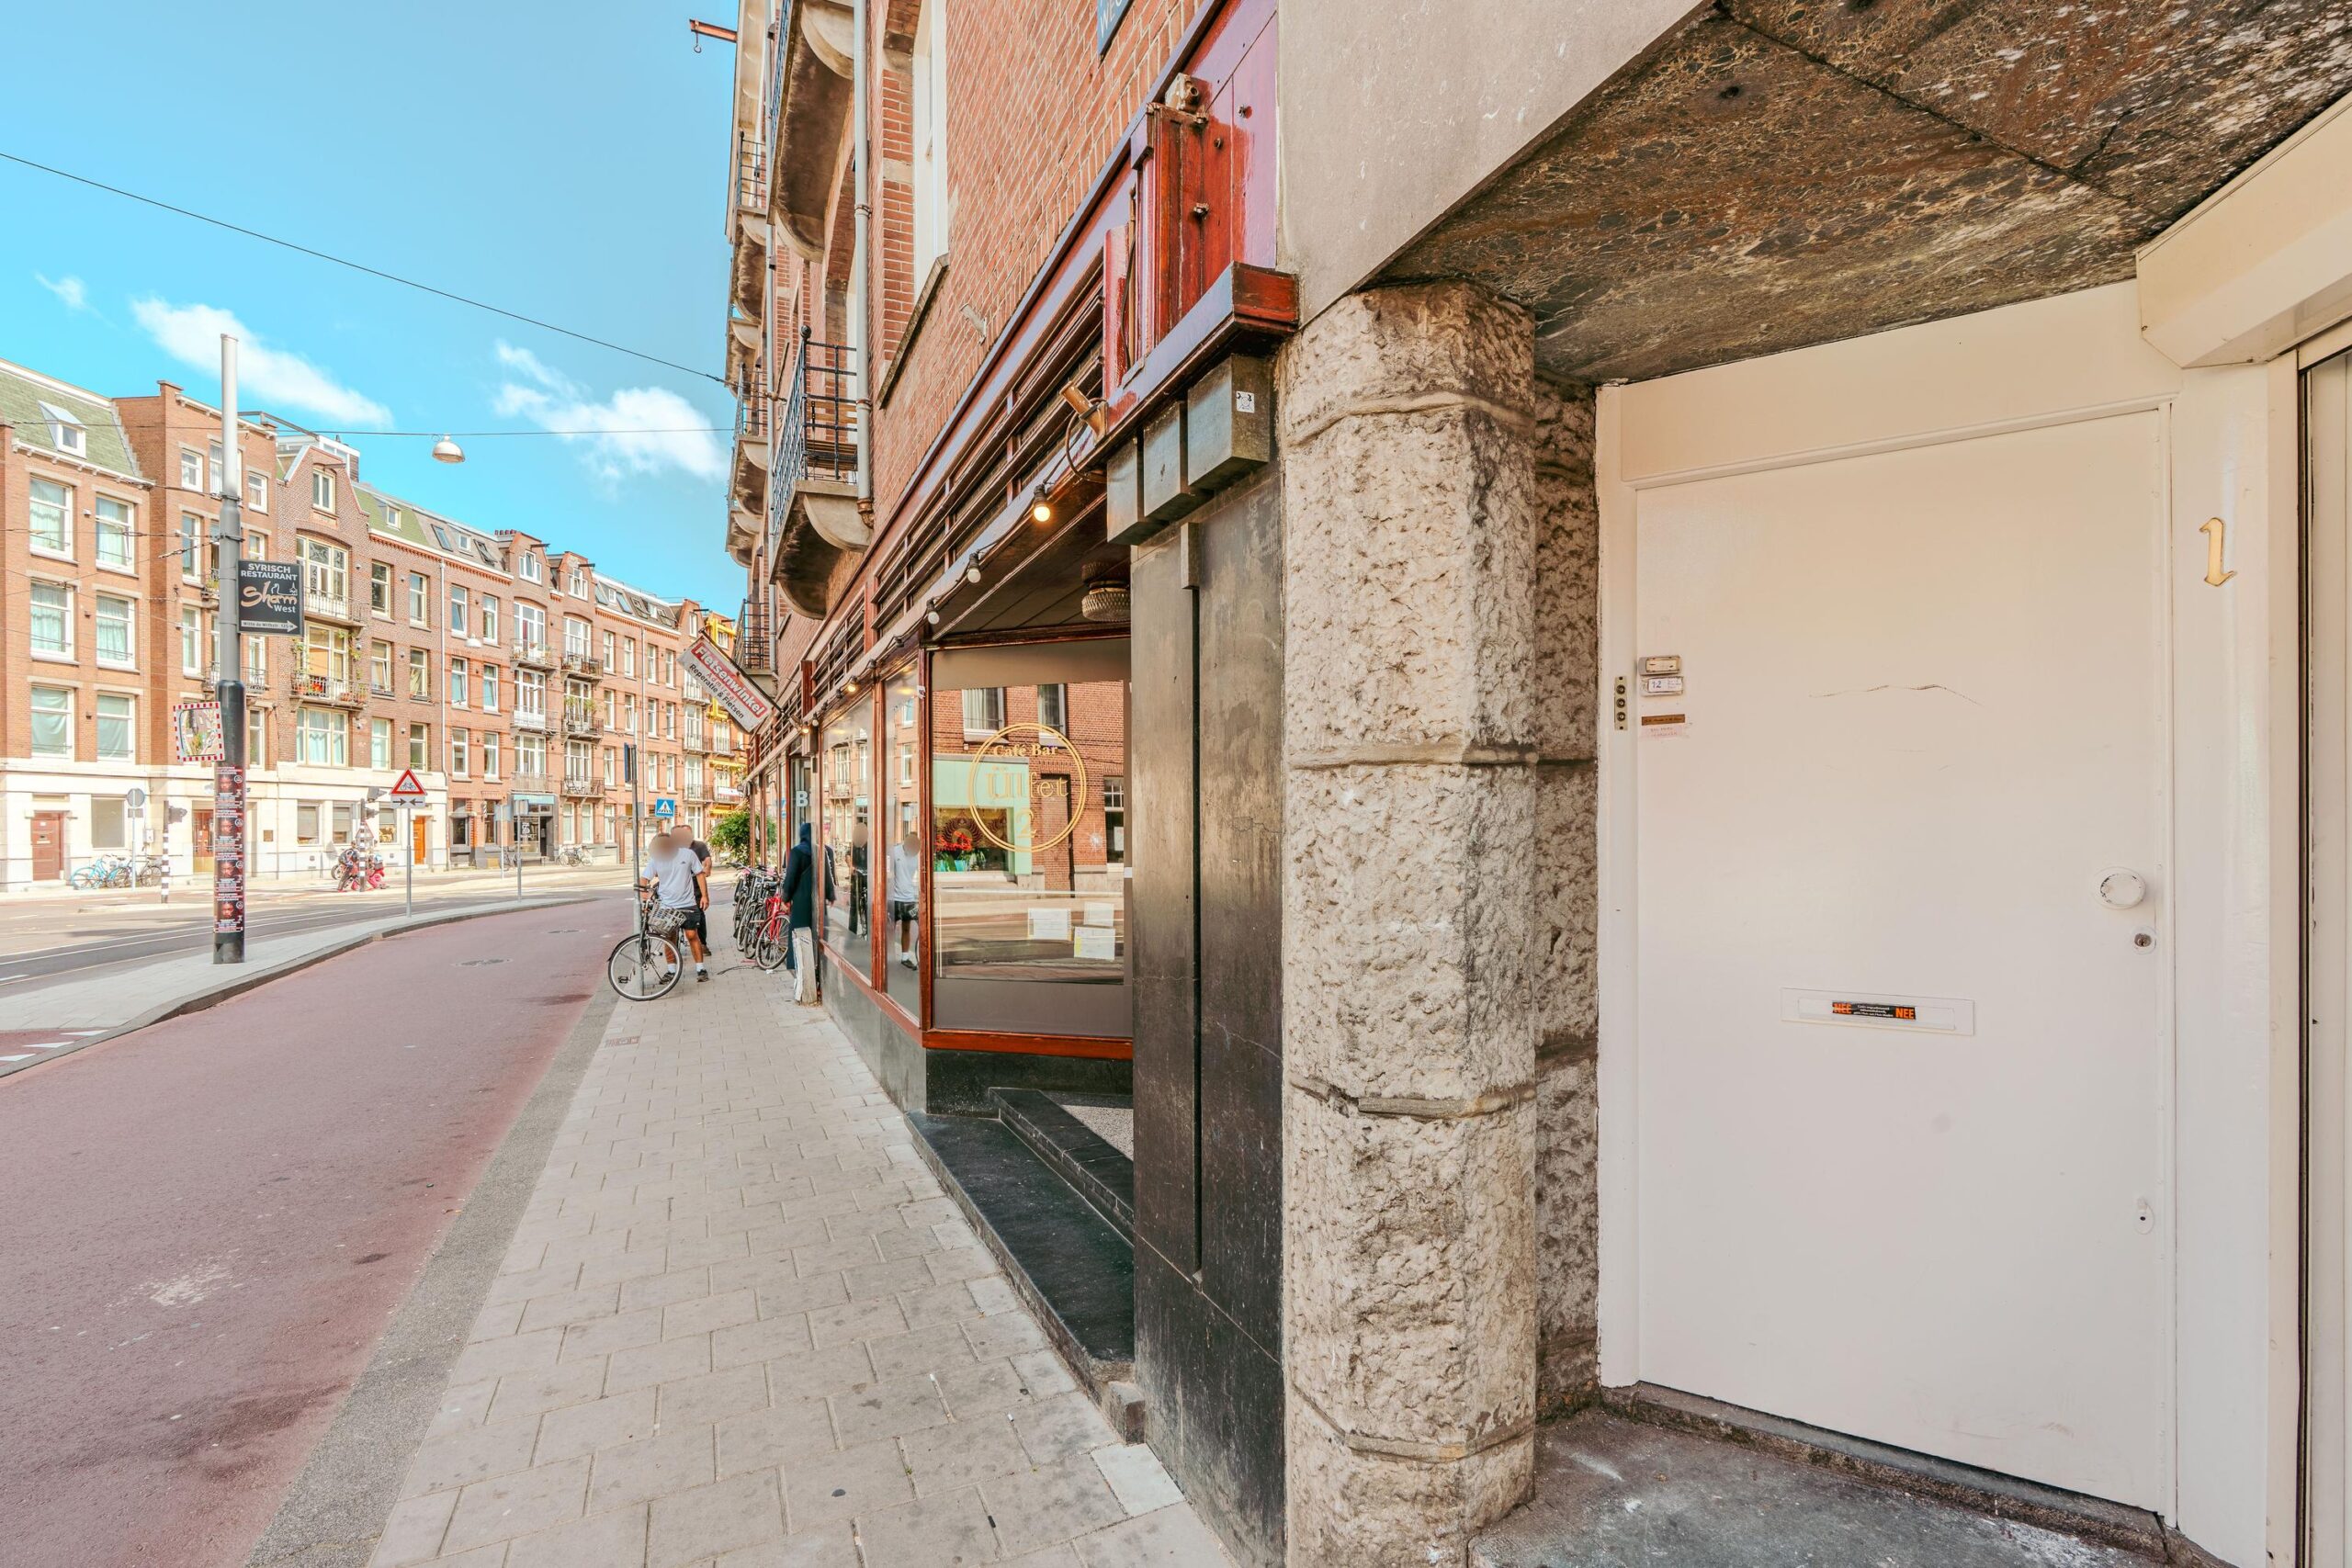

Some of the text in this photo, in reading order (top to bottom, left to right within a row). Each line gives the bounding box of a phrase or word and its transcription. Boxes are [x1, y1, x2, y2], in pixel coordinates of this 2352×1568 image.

[2199, 517, 2235, 587] 1
[241, 570, 298, 581] RESTAURANT
[248, 563, 290, 573] SYRISCH
[241, 581, 298, 609] Sham
[274, 604, 296, 613] West
[695, 647, 765, 715] Fietsenwinkel
[722, 696, 744, 718] Fietsen
[993, 742, 1058, 757] Café Bar
[796, 791, 808, 807] B
[1895, 1008, 1915, 1019] NEE
